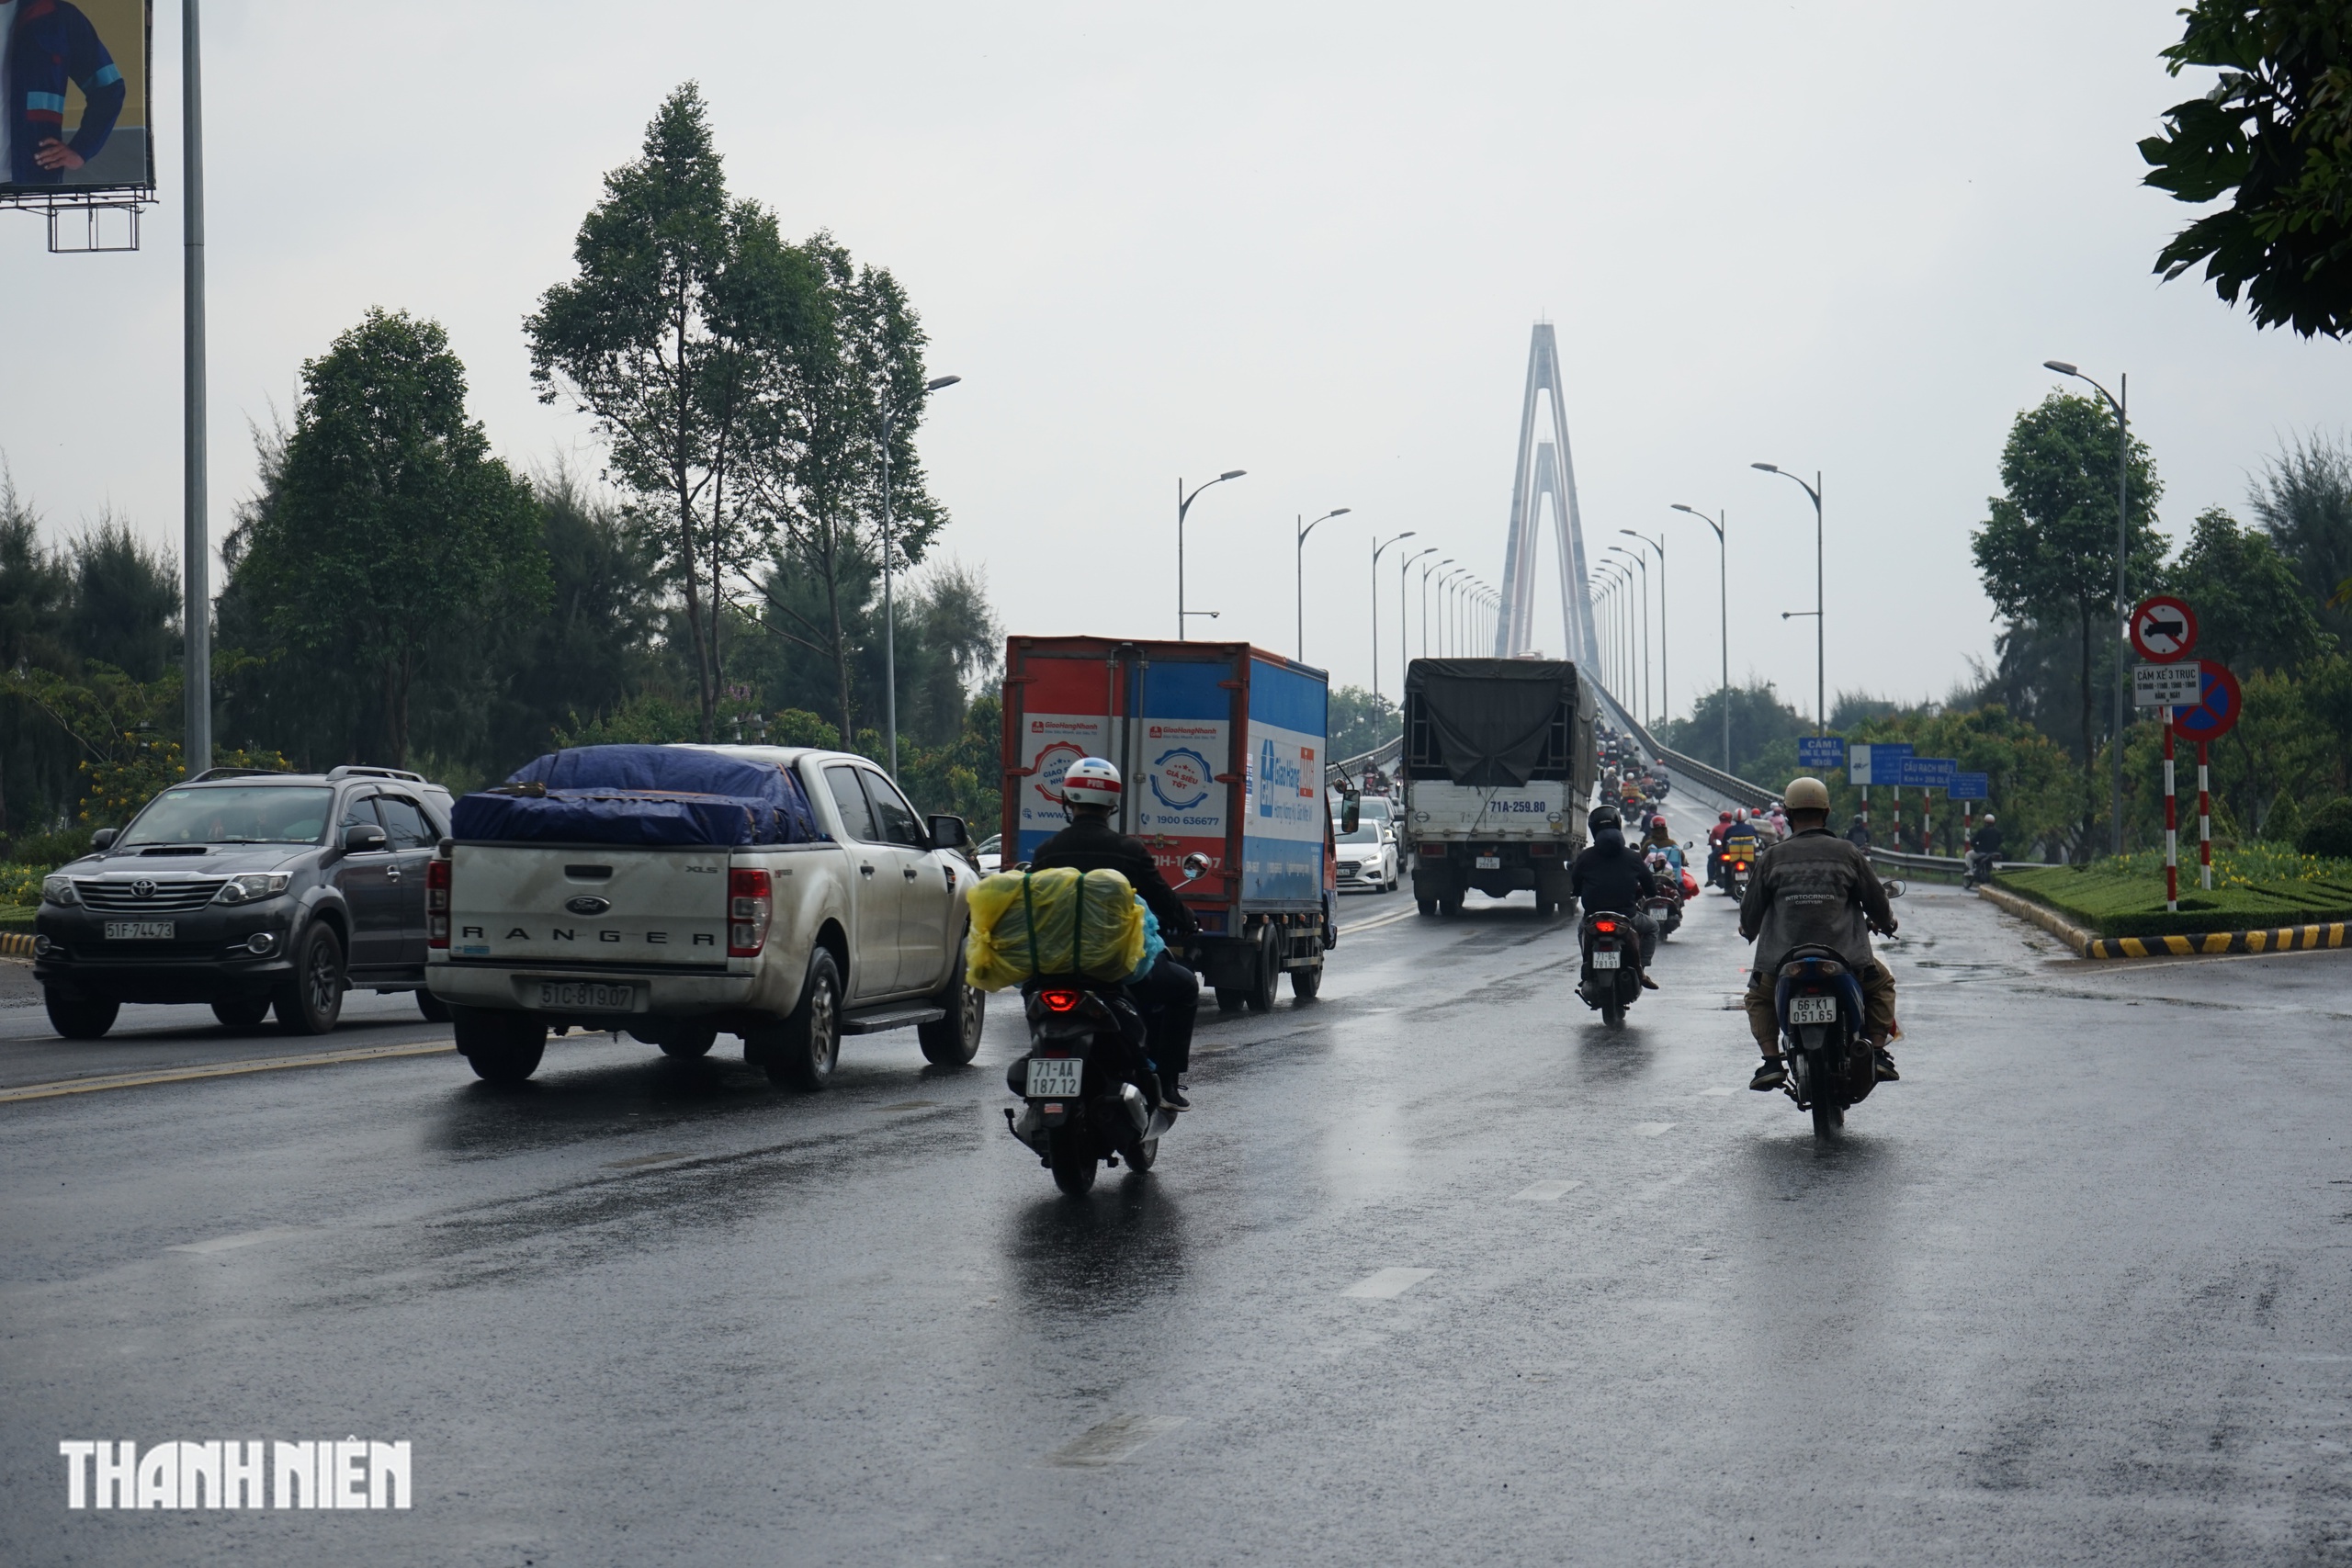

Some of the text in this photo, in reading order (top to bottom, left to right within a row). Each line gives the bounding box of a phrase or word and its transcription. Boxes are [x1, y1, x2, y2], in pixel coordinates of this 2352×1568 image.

[2137, 668, 2196, 682] CẤM XE 3 TRỤC
[1045, 721, 1098, 731] GiaoHangNhanh
[1163, 726, 1217, 736] GiaoHangNhanh
[1043, 768, 1063, 779] GIAO
[1166, 769, 1199, 785] GIÁ SIÊU
[1172, 779, 1188, 790] TỐT
[1490, 800, 1546, 813] 71A-259.80
[1157, 815, 1220, 826] 1900 636677
[685, 864, 719, 874] XLS
[107, 923, 173, 938] 51F-744.73
[461, 926, 716, 947] RANGER
[1596, 951, 1617, 961] 71-B4
[1594, 960, 1618, 969] 781.91
[541, 986, 630, 1008] 51C-819.07
[1797, 998, 1828, 1011] 66-K1
[1793, 1010, 1834, 1022] 051.65
[1035, 1062, 1074, 1077] 71-AA
[1033, 1078, 1077, 1094] 187.12
